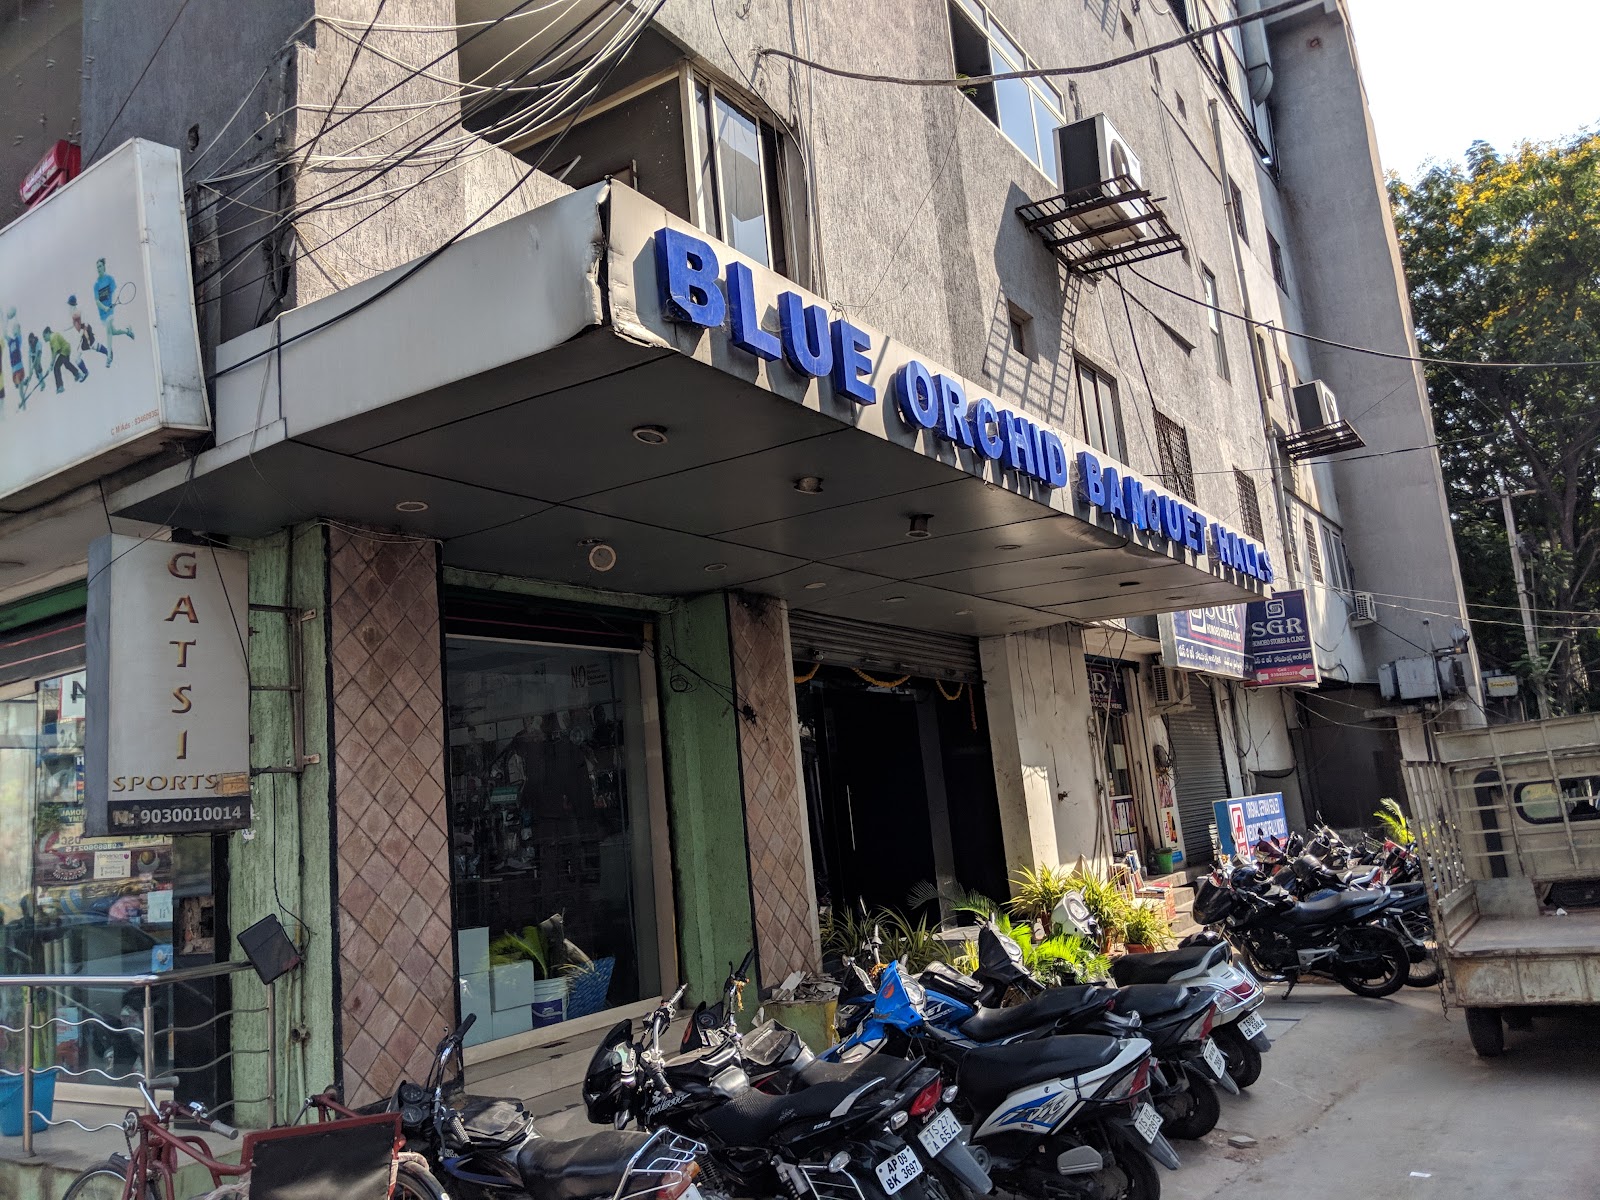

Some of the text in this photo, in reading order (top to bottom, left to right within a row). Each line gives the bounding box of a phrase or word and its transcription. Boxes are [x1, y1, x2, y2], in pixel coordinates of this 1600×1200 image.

[655, 227, 1274, 585] BLUE ORCHID BANQUET HALLS
[1251, 617, 1304, 637] SGR
[112, 774, 218, 793] SPORTS
[140, 806, 242, 824] 9030010014
[926, 1124, 940, 1139] TS
[932, 1120, 960, 1152] A 6541
[886, 1152, 908, 1175] AP 09
[885, 1159, 919, 1191] BK 3697
